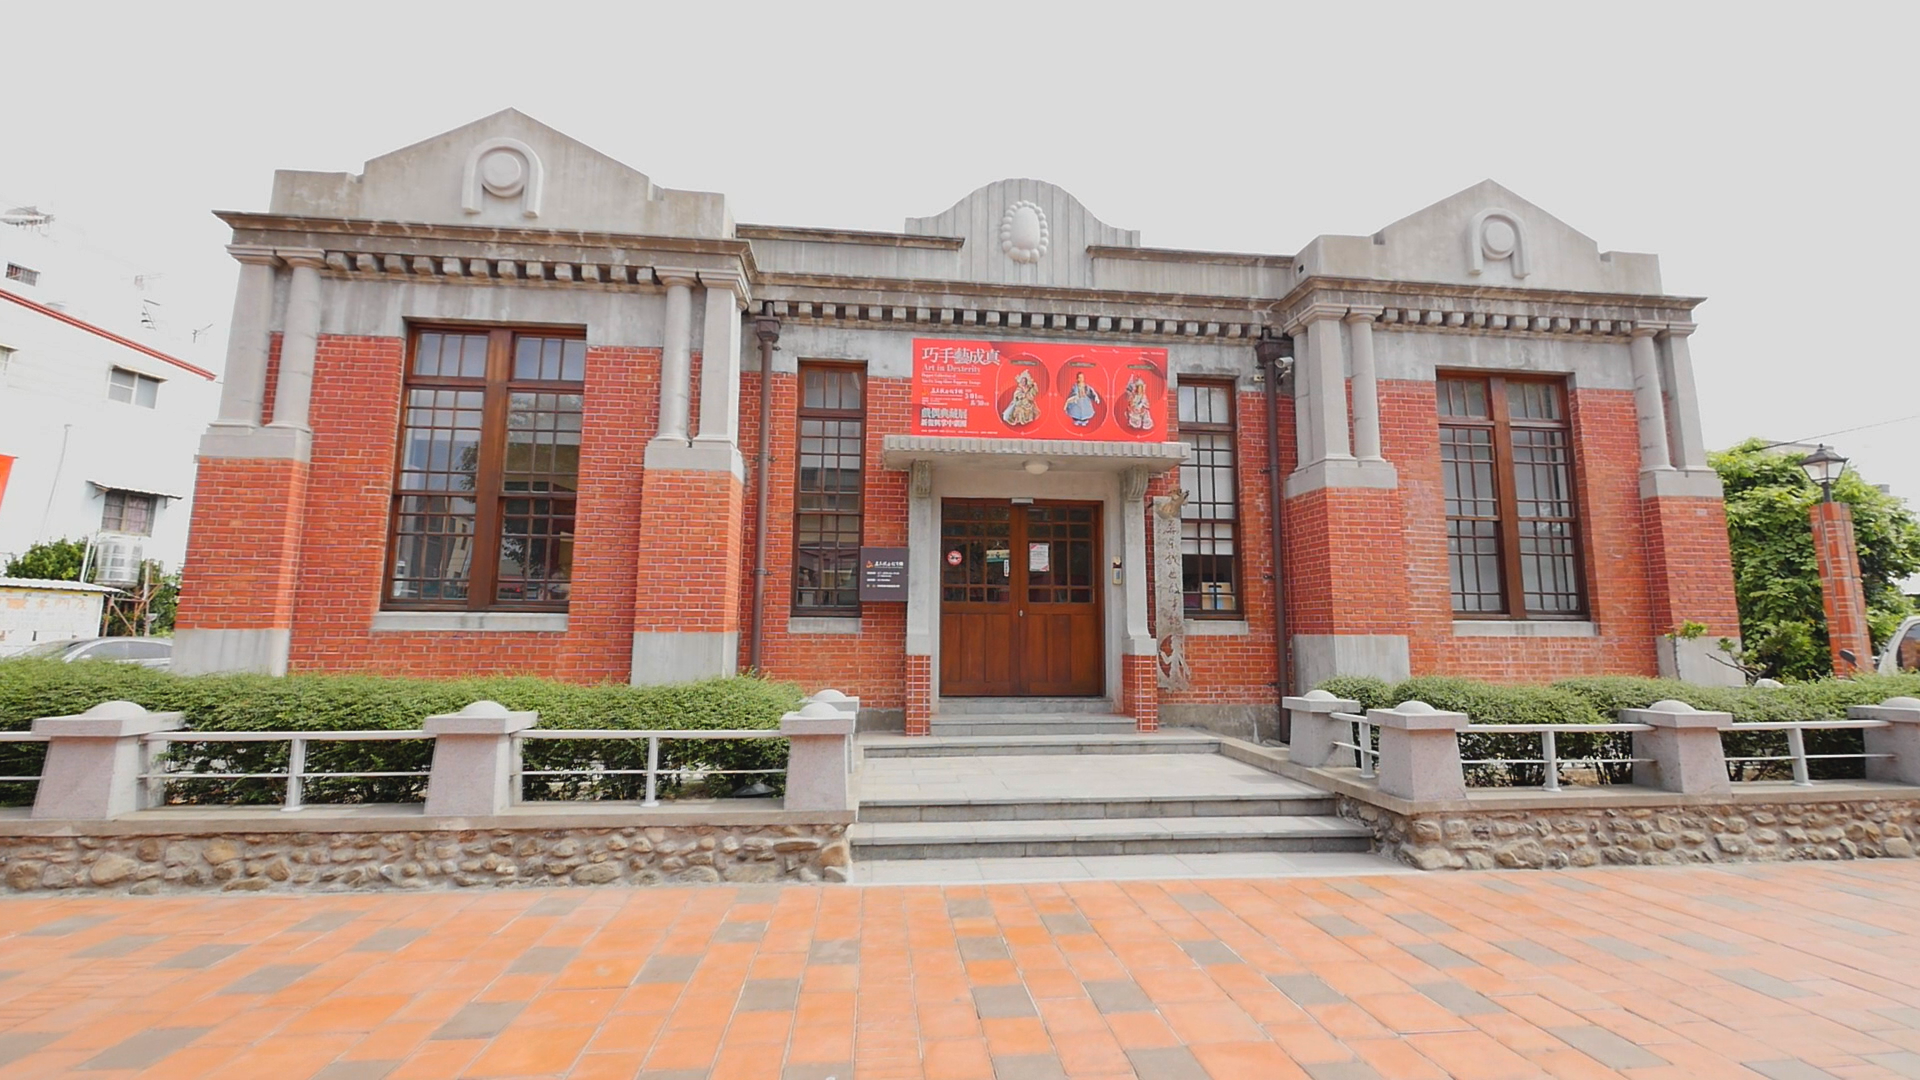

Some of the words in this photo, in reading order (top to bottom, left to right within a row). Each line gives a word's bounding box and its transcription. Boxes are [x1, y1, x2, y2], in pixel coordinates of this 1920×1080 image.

[922, 347, 1000, 365] 巧手藝成真
[947, 364, 980, 373] Dexterity
